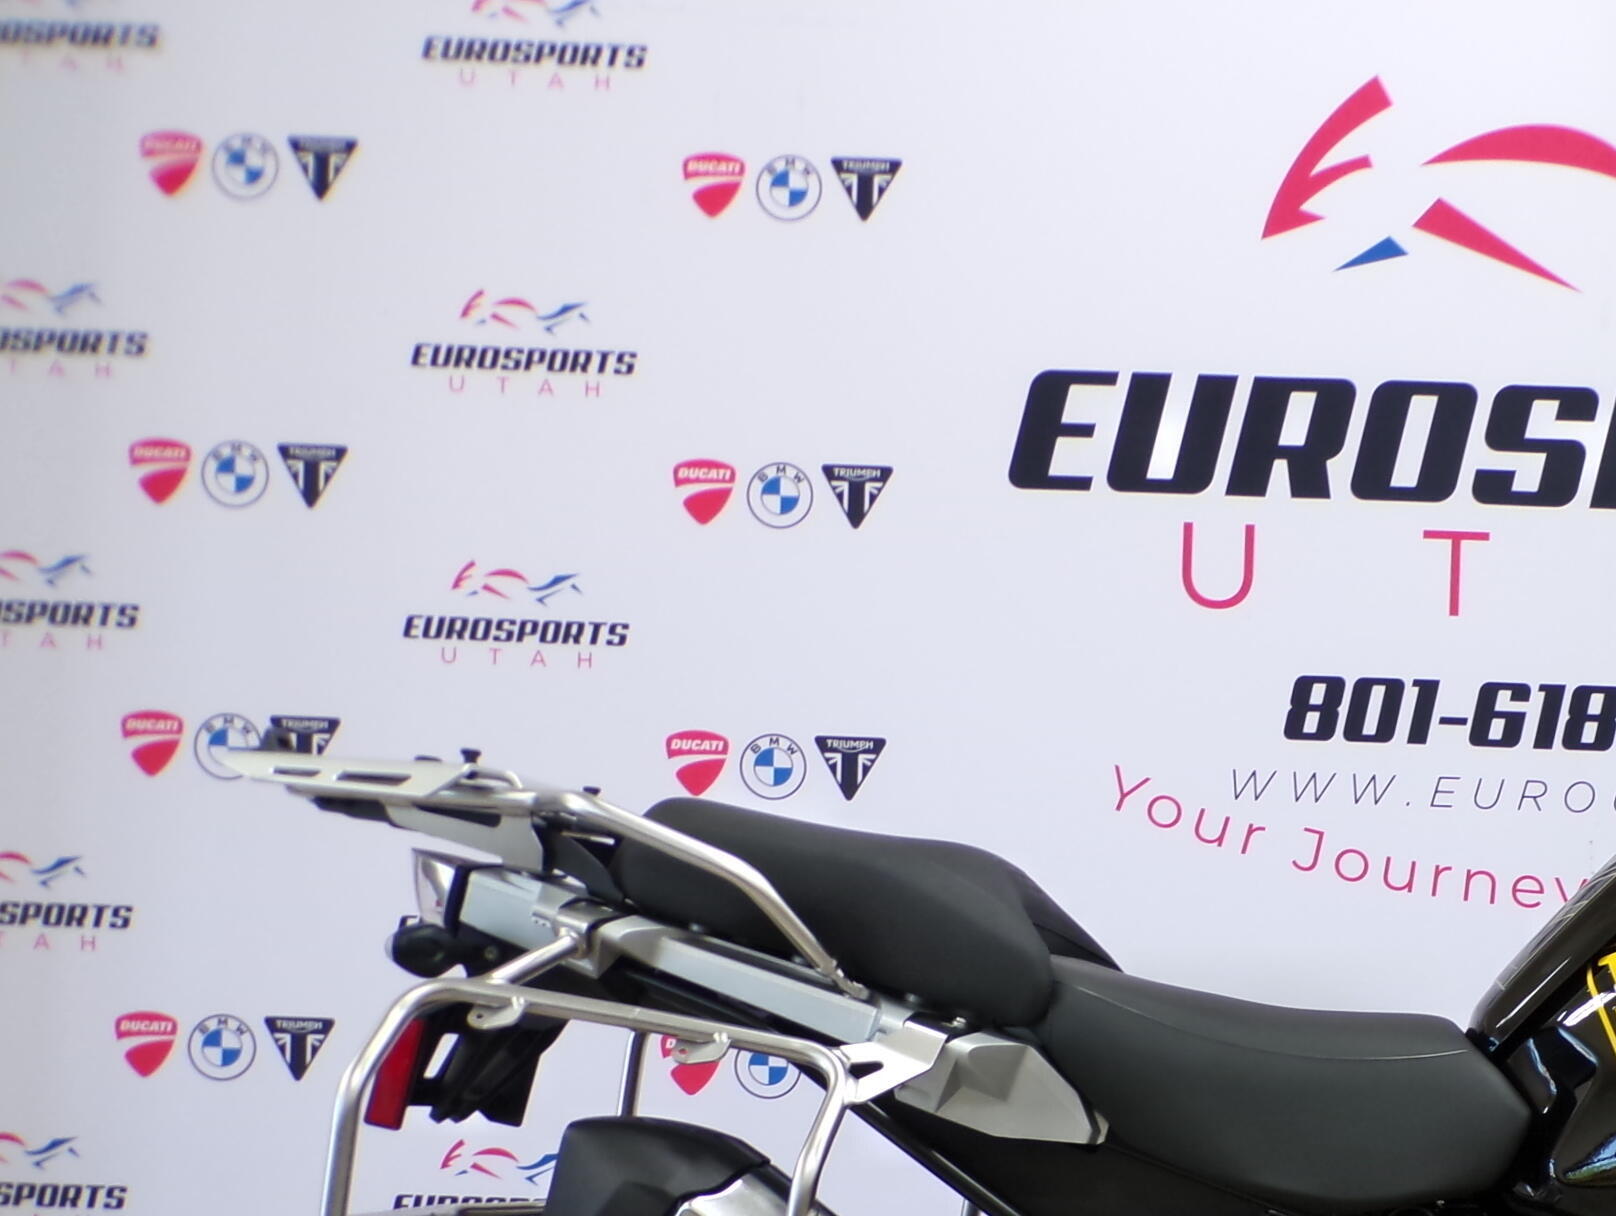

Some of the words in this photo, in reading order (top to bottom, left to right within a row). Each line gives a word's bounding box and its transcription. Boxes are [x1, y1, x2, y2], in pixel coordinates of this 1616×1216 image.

[421, 35, 648, 69] EUROSPORTS
[687, 160, 743, 174] DUCATI
[412, 342, 638, 376] EUROSPORTS
[450, 376, 602, 398] UTAH
[133, 445, 189, 460] DUCATI
[677, 467, 733, 482] DUCATI
[832, 466, 883, 480] TRIUMPH
[0, 600, 140, 629] SPORTS
[403, 615, 630, 647] EUROSPORTS
[441, 647, 593, 669] UTAH
[125, 719, 180, 734] DUCATI
[280, 717, 330, 731] TRIUMPH
[670, 738, 725, 753] DUCATI
[825, 737, 876, 751] TRIUMPH
[1113, 764, 1266, 855] Your
[119, 1019, 174, 1034] DUCATI
[274, 1018, 325, 1032] TRIUMPH
